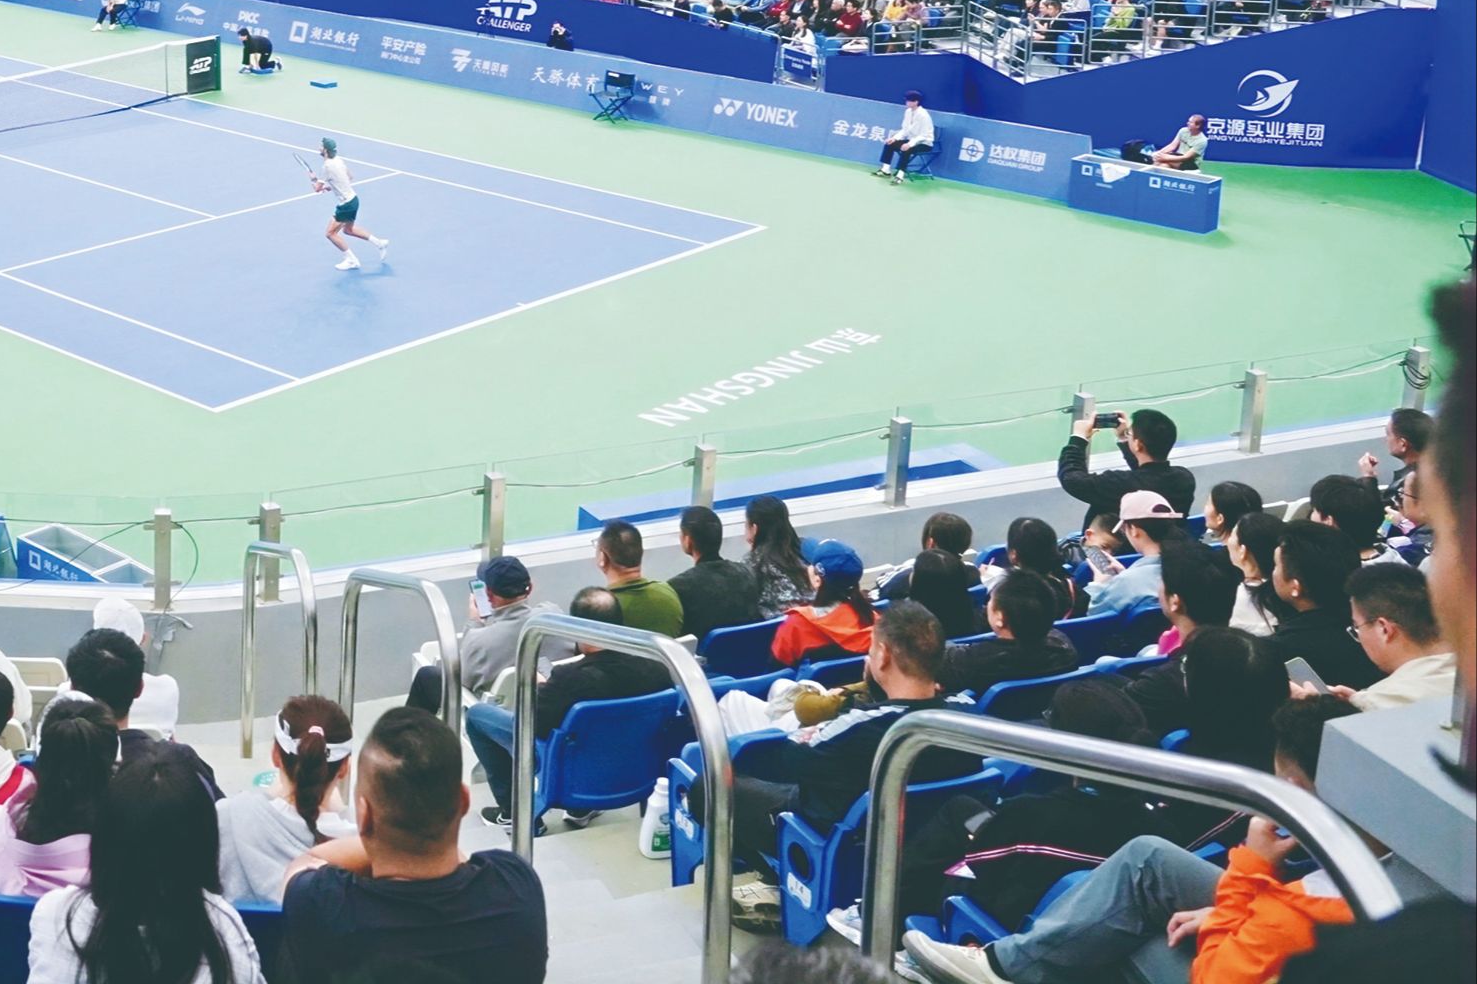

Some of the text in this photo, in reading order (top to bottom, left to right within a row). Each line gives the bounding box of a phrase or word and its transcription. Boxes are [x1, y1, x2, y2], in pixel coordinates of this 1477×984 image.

[238, 11, 260, 24] PICC
[381, 36, 427, 56] 平安产险
[189, 57, 212, 70] ATP
[641, 82, 684, 96] WEY
[746, 103, 798, 128] YONEX
[1207, 117, 1325, 141] 京源实业集团
[1207, 135, 1324, 147] JINGYUANSHIYEJITUAN
[989, 144, 1045, 166] 达权集团
[987, 158, 1044, 173] DAQUAN GROUP
[637, 350, 823, 427] JINGSHAN
